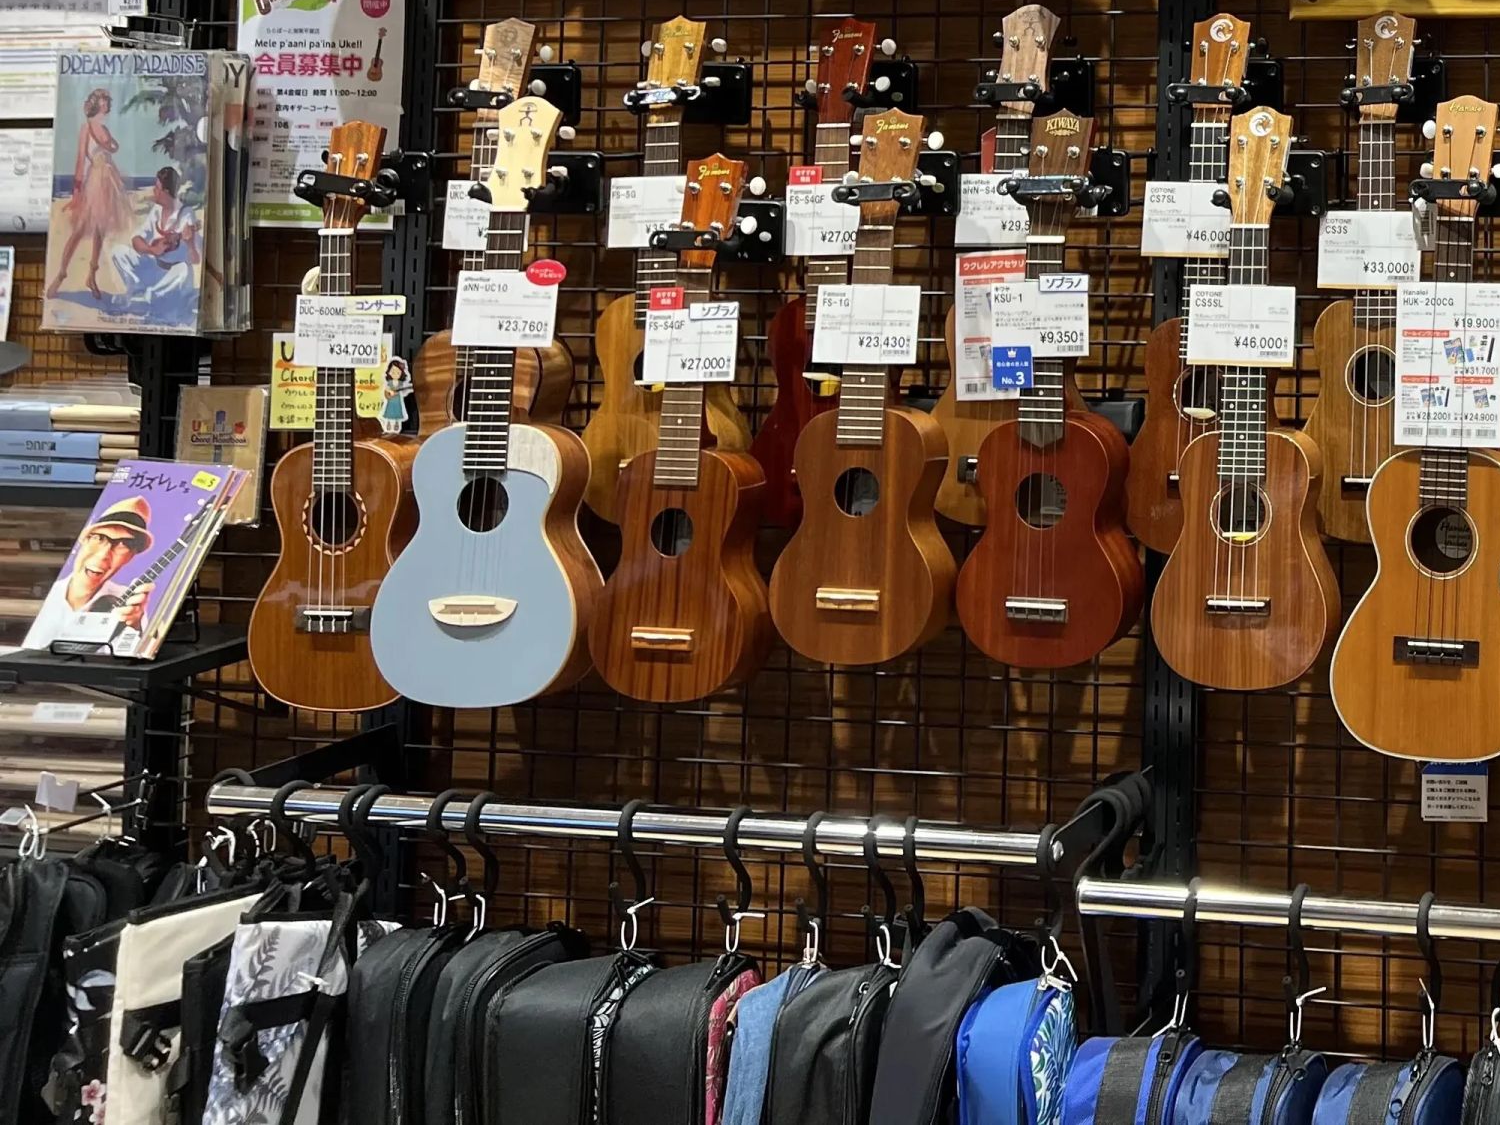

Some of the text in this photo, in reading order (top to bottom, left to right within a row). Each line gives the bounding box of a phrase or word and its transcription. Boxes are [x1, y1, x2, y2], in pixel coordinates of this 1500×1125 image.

[832, 29, 864, 42] Famous
[254, 39, 277, 49] Mele
[60, 53, 206, 75] DREAMY PARADISE
[254, 53, 363, 76] 会員募集中
[876, 119, 910, 134] Famous
[1046, 118, 1081, 131] KIWAYA
[697, 164, 730, 178] Famous
[789, 194, 825, 205] FS-S4GF
[1149, 194, 1176, 204] CS7SL
[1186, 229, 1231, 242] ¥46,000
[1325, 225, 1348, 234] CS3S
[1363, 261, 1410, 274] ¥33,000
[1045, 276, 1082, 290] ソプラノ
[994, 292, 1023, 304] KSU-1
[1403, 288, 1429, 296] Hanalei
[355, 299, 402, 312] コンサート
[822, 298, 850, 308] FS-1G
[1195, 298, 1224, 308] CS5SL
[299, 306, 347, 317] DUC-600ME
[702, 304, 738, 318] ソプラノ
[498, 320, 543, 332] ¥23,760
[649, 321, 685, 331] FS-S4GF
[1454, 317, 1495, 329] ¥19,900
[858, 335, 906, 349] ¥23,430
[1039, 330, 1079, 345] ¥9,350
[1234, 336, 1283, 349] ¥46,000
[329, 343, 373, 357] ¥34,700
[680, 357, 726, 370] ¥27,000
[280, 369, 314, 385] Chord
